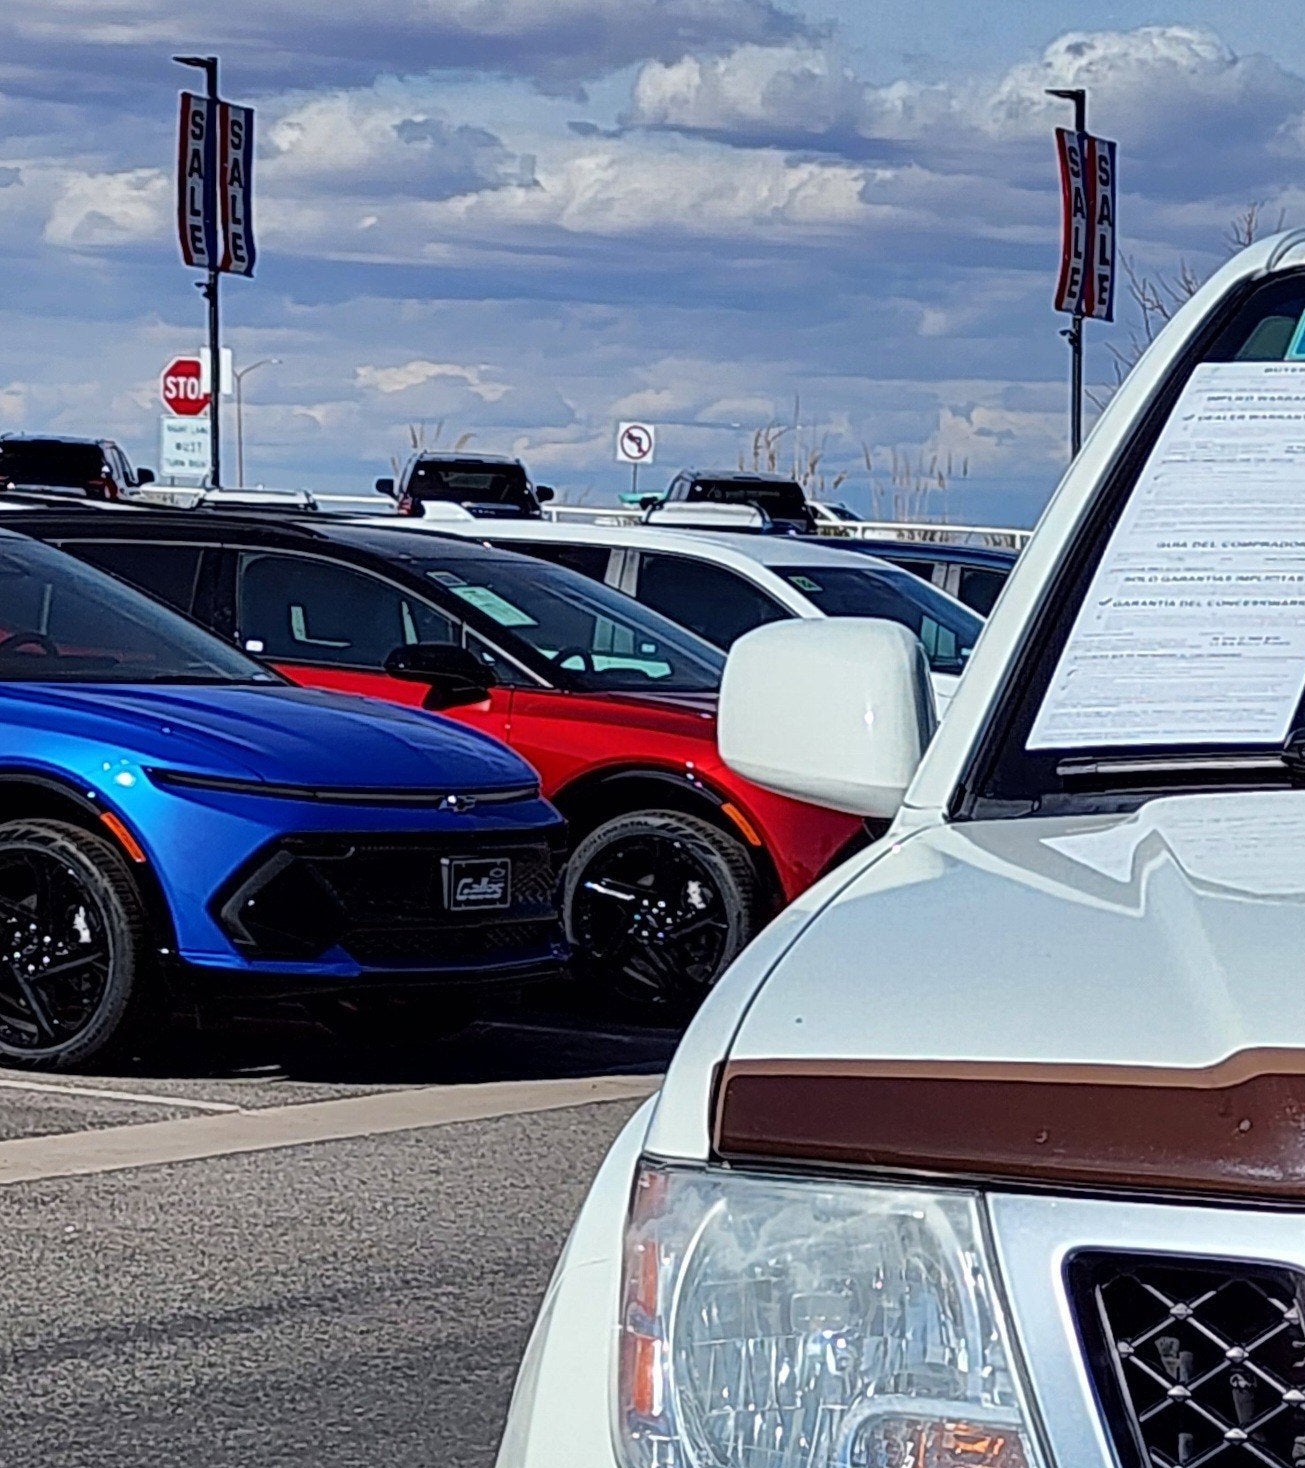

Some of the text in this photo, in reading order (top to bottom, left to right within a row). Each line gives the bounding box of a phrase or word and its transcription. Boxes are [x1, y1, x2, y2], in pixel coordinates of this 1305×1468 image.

[188, 109, 206, 256] SALE
[228, 118, 246, 263] SALE
[1067, 145, 1086, 300] SALE
[1097, 154, 1113, 306] SALE
[164, 376, 205, 400] STO
